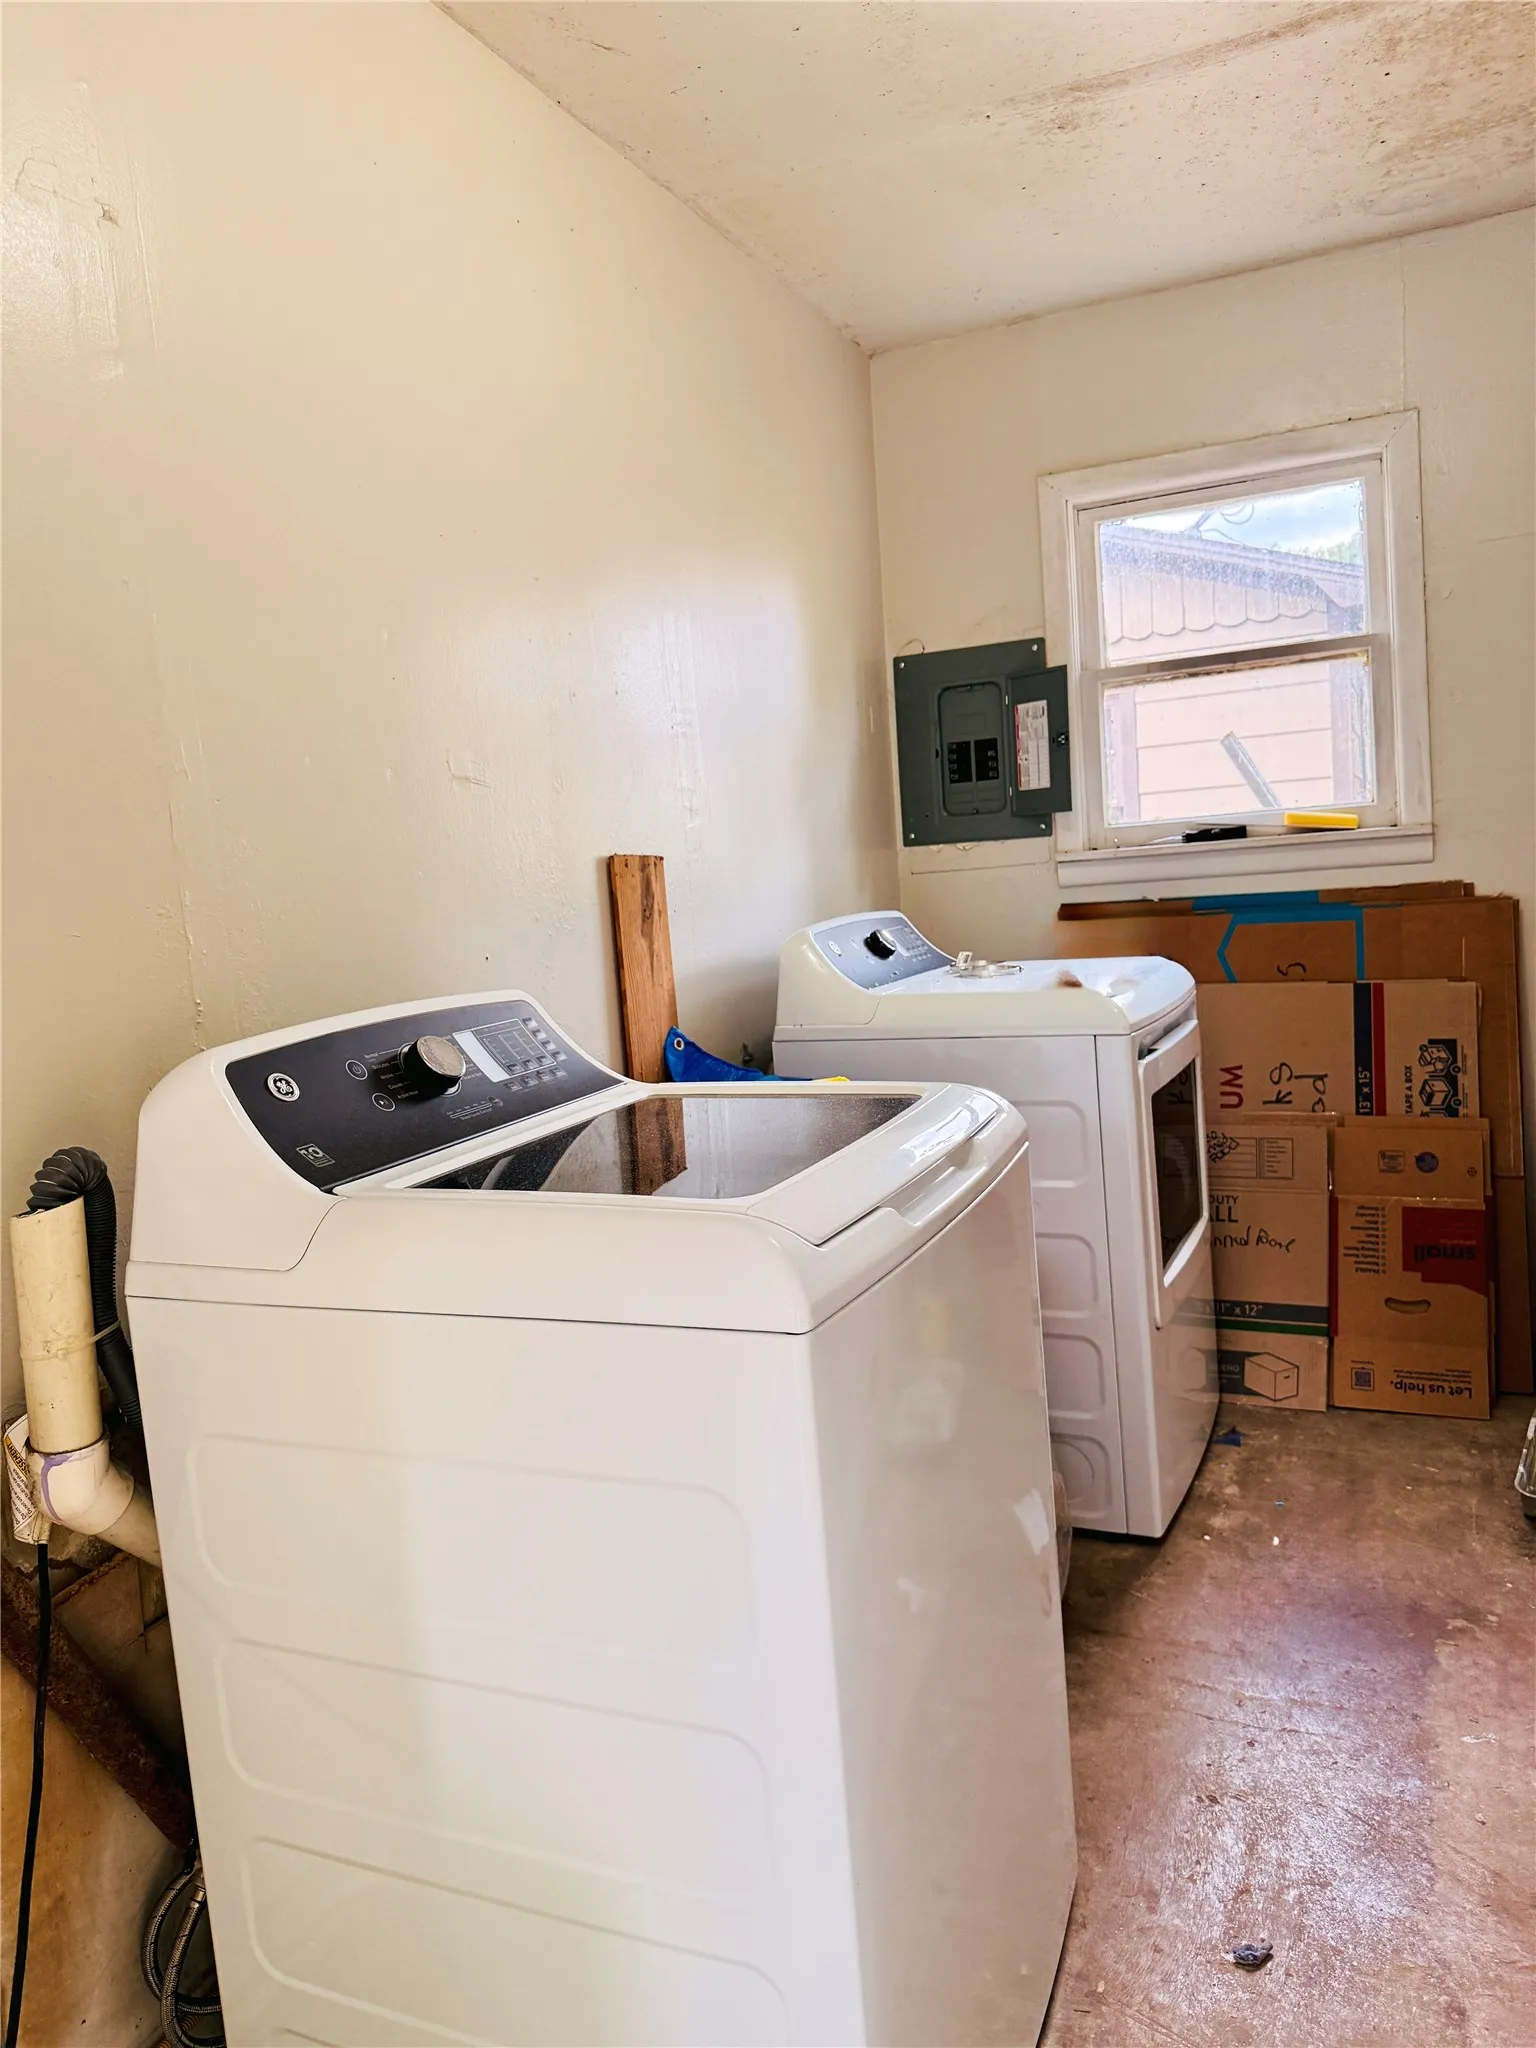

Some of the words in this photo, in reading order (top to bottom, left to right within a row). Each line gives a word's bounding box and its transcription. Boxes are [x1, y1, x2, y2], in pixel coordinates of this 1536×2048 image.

[1262, 1062, 1294, 1105] ks
[1404, 1065, 1412, 1084] BOX
[1219, 1065, 1243, 1109] UM
[1404, 1093, 1412, 1114] TAPE
[1414, 1244, 1476, 1263] small
[1390, 1379, 1425, 1395] help.
[1429, 1384, 1445, 1394] us
[1449, 1385, 1472, 1399] Let
[7, 1442, 30, 1476] ISSEMENT
